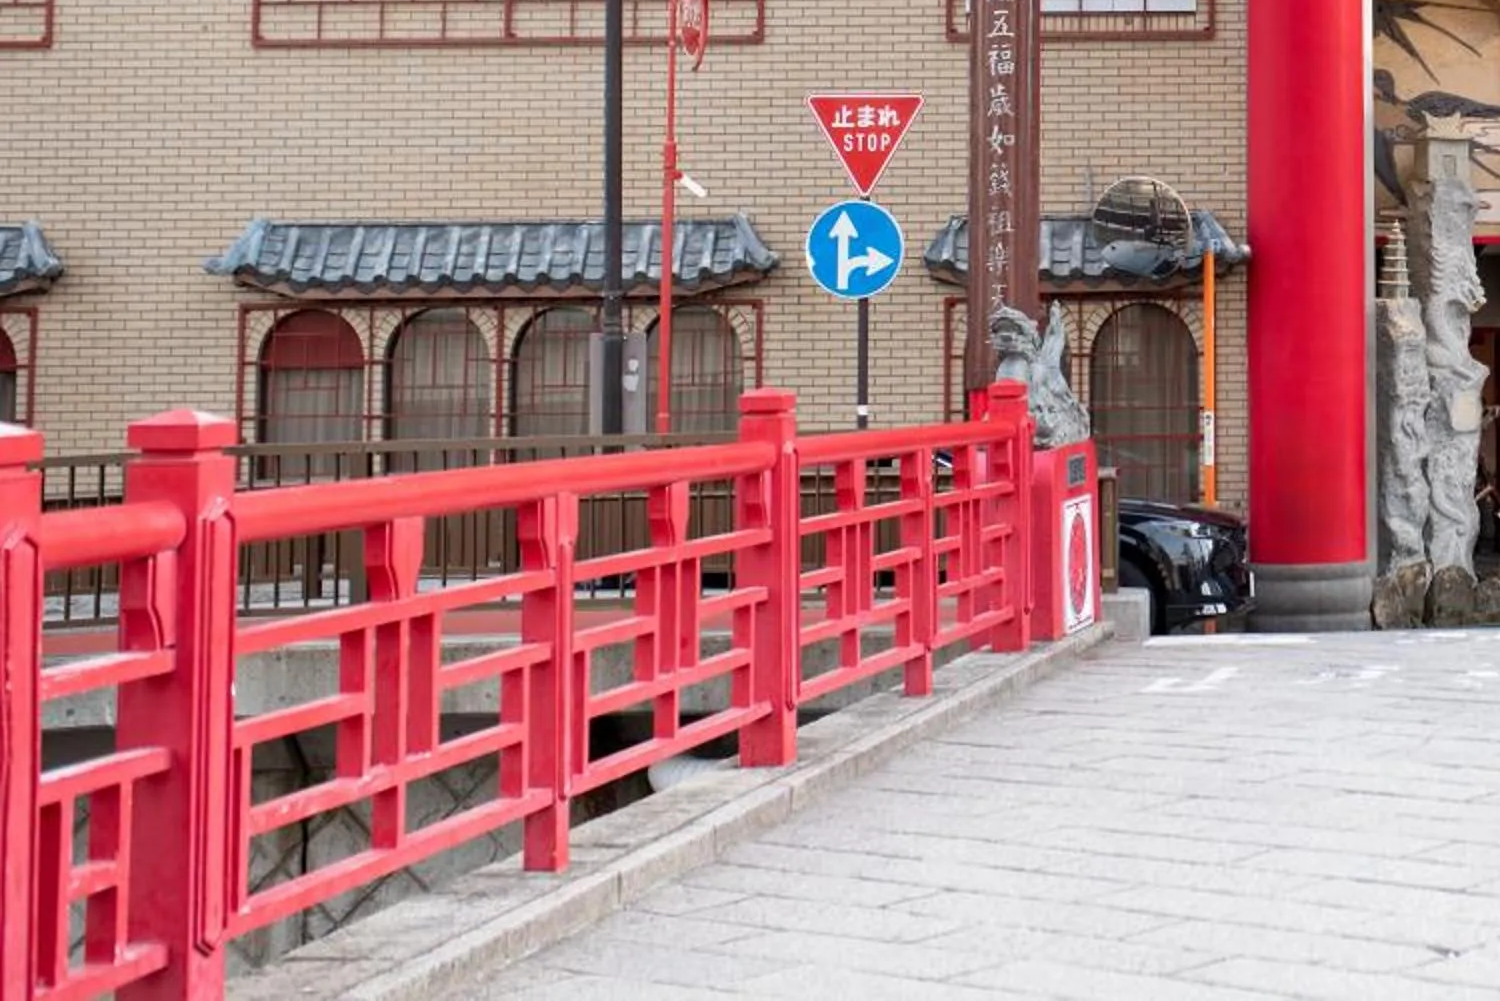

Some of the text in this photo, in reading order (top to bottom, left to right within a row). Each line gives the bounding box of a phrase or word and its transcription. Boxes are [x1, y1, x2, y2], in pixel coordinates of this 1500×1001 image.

[831, 104, 901, 128] 止まれ
[843, 133, 892, 152] STOP
